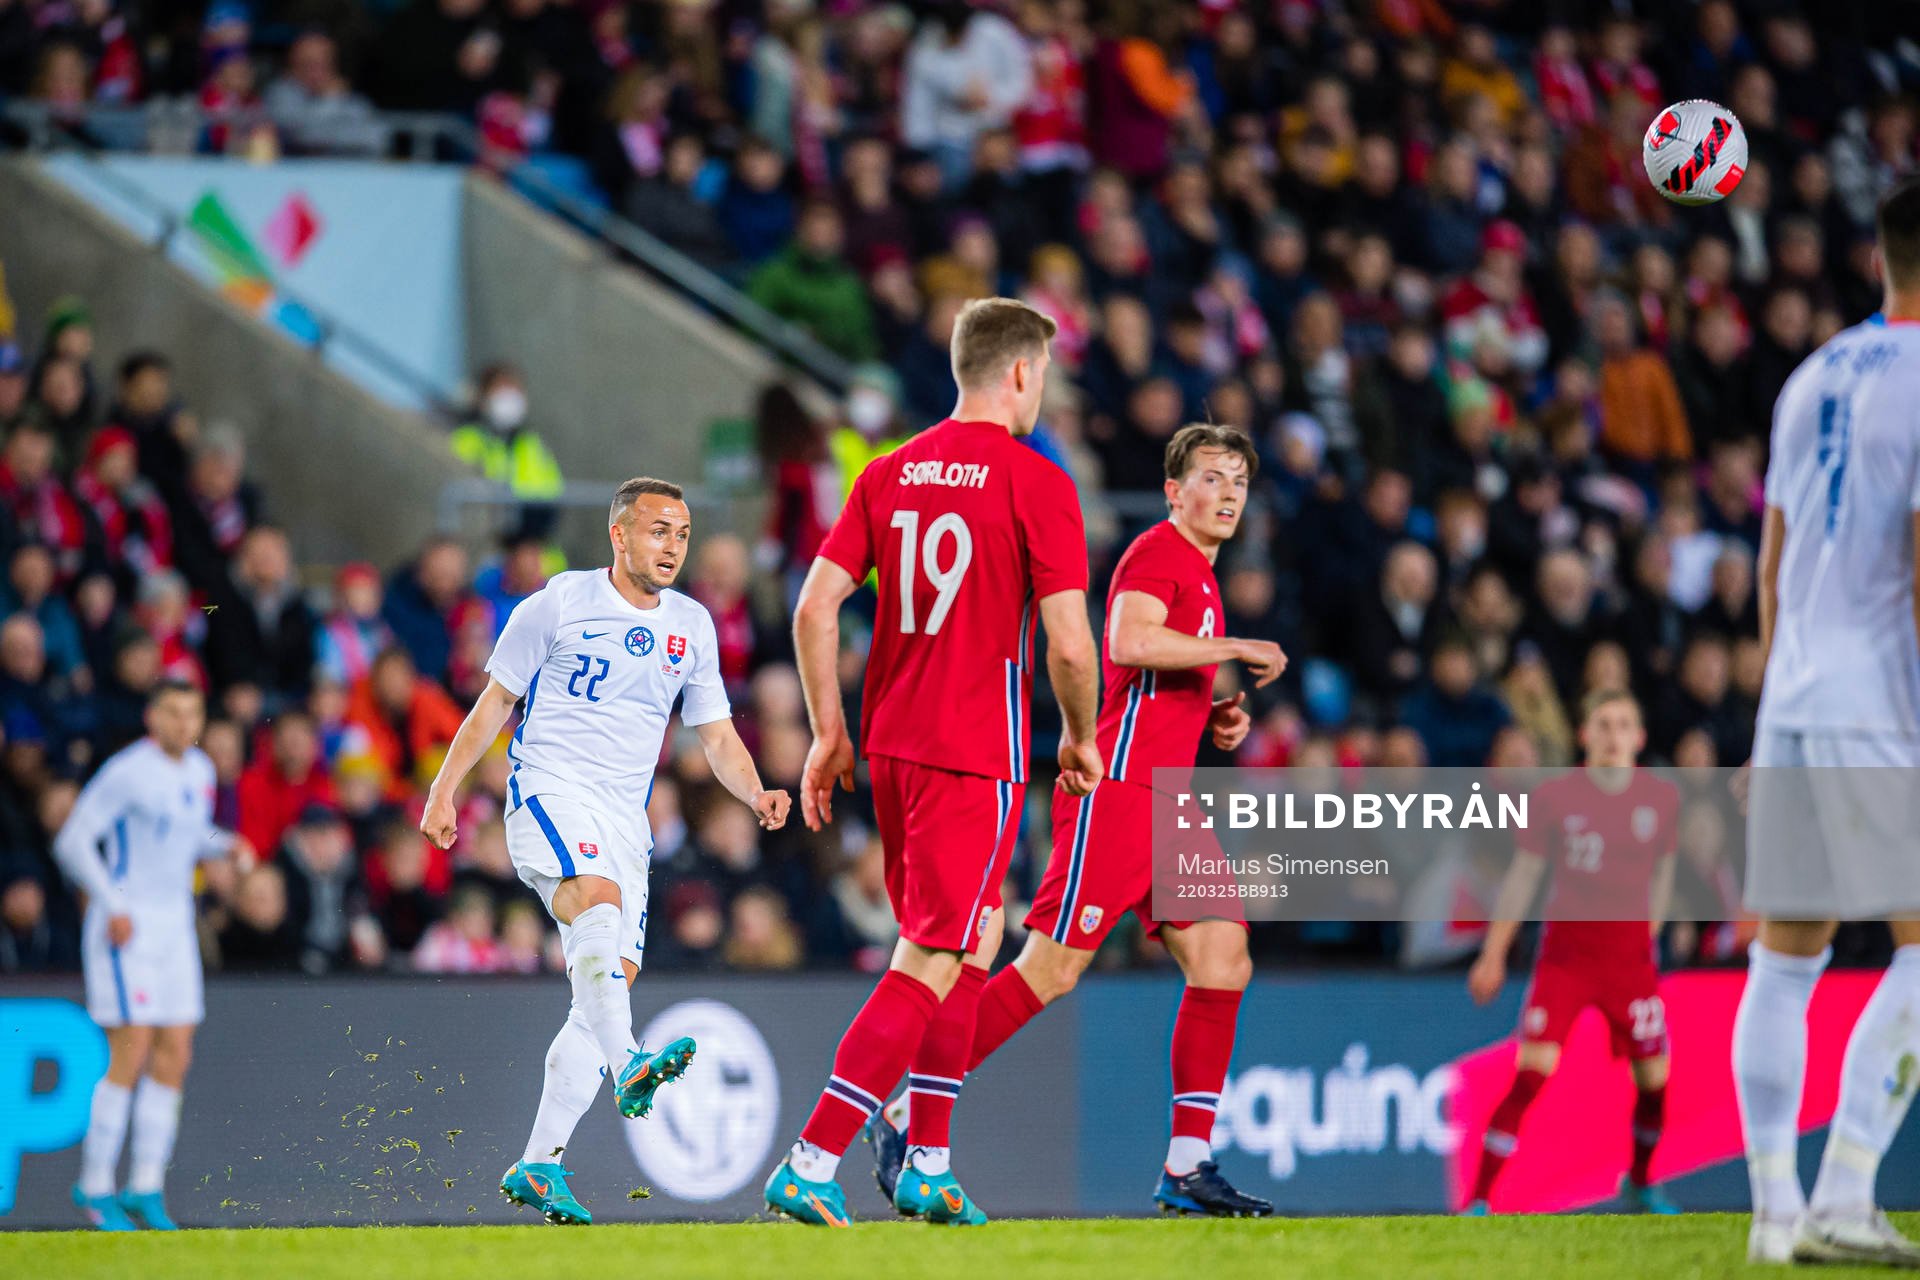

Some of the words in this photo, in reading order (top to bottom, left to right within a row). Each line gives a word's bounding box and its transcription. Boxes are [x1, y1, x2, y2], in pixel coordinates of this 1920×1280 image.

[899, 461, 989, 489] SØRLOTH
[890, 510, 973, 635] 19
[568, 654, 610, 702] 22
